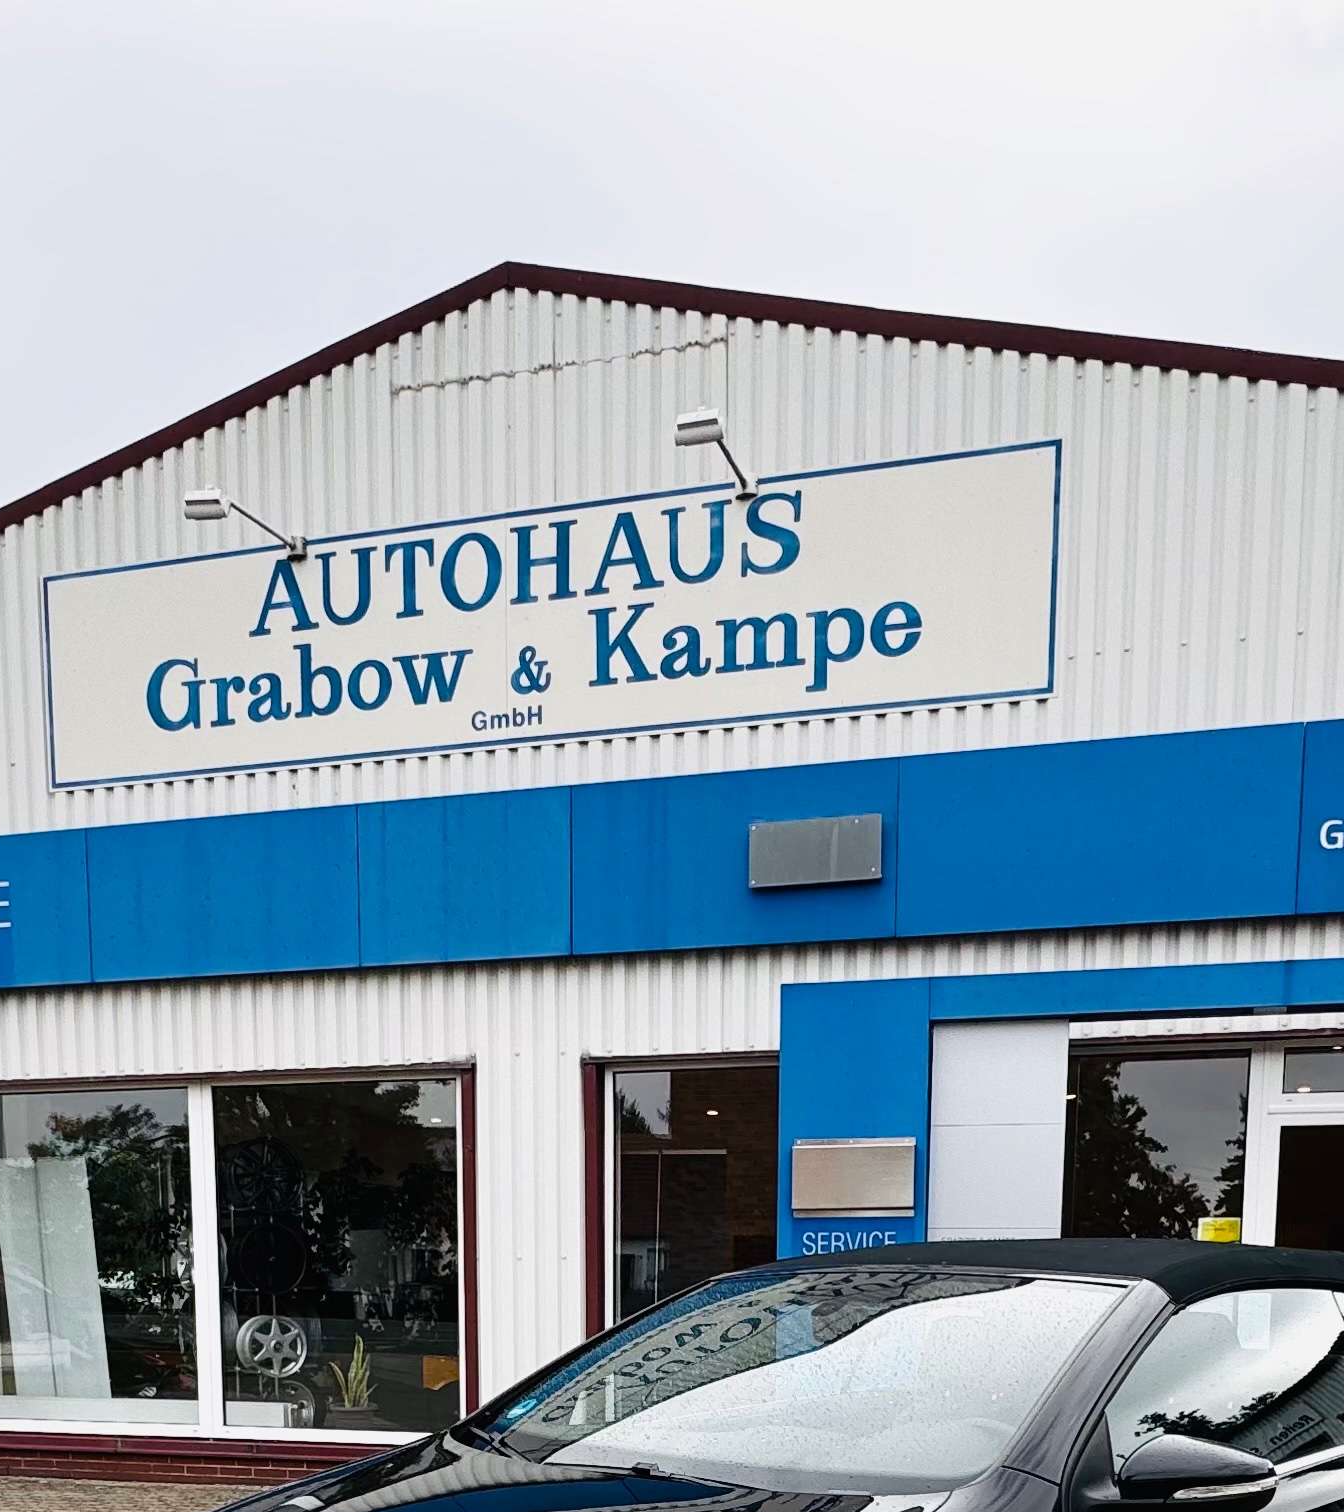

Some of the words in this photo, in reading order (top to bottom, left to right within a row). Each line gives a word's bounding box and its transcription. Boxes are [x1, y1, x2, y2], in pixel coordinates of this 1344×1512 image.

[249, 490, 803, 638] AUTOHAUS
[146, 644, 473, 733] Grabow
[510, 645, 552, 695] &
[587, 600, 923, 693] Kampe
[471, 705, 544, 732] GmbH
[801, 1231, 897, 1256] SERVICE
